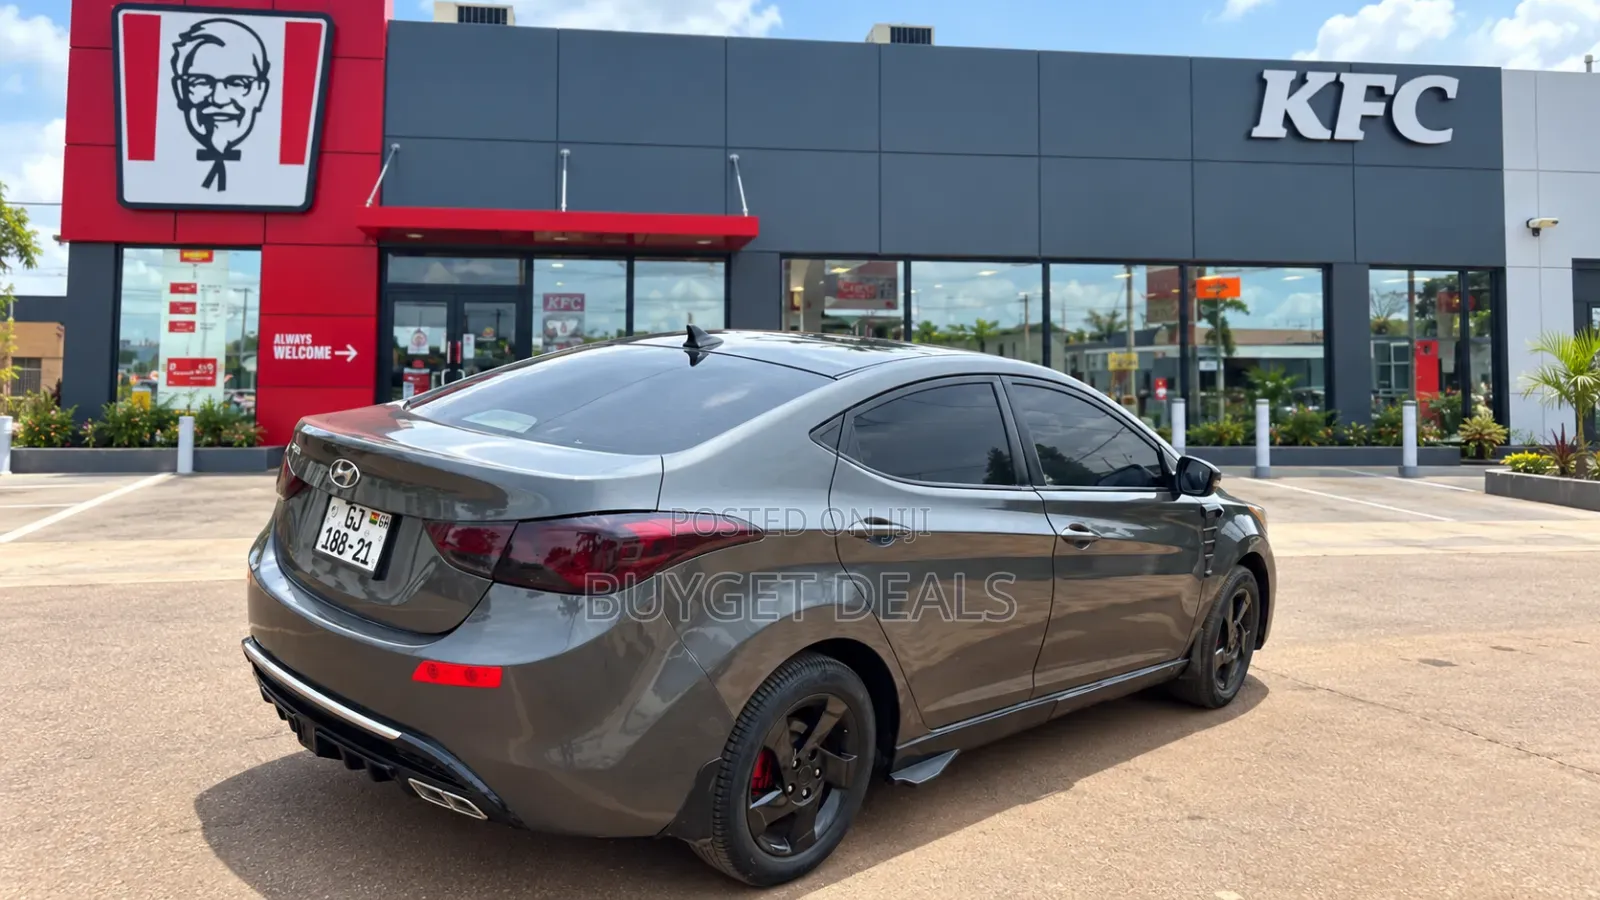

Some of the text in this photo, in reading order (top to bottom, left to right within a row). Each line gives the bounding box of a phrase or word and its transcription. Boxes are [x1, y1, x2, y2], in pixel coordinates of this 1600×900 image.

[1251, 69, 1459, 144] KFC
[547, 296, 582, 310] KFC
[273, 333, 312, 345] ALWAYS
[273, 346, 332, 360] WELCOME
[344, 506, 366, 532] GJ
[322, 527, 373, 565] 188-21
